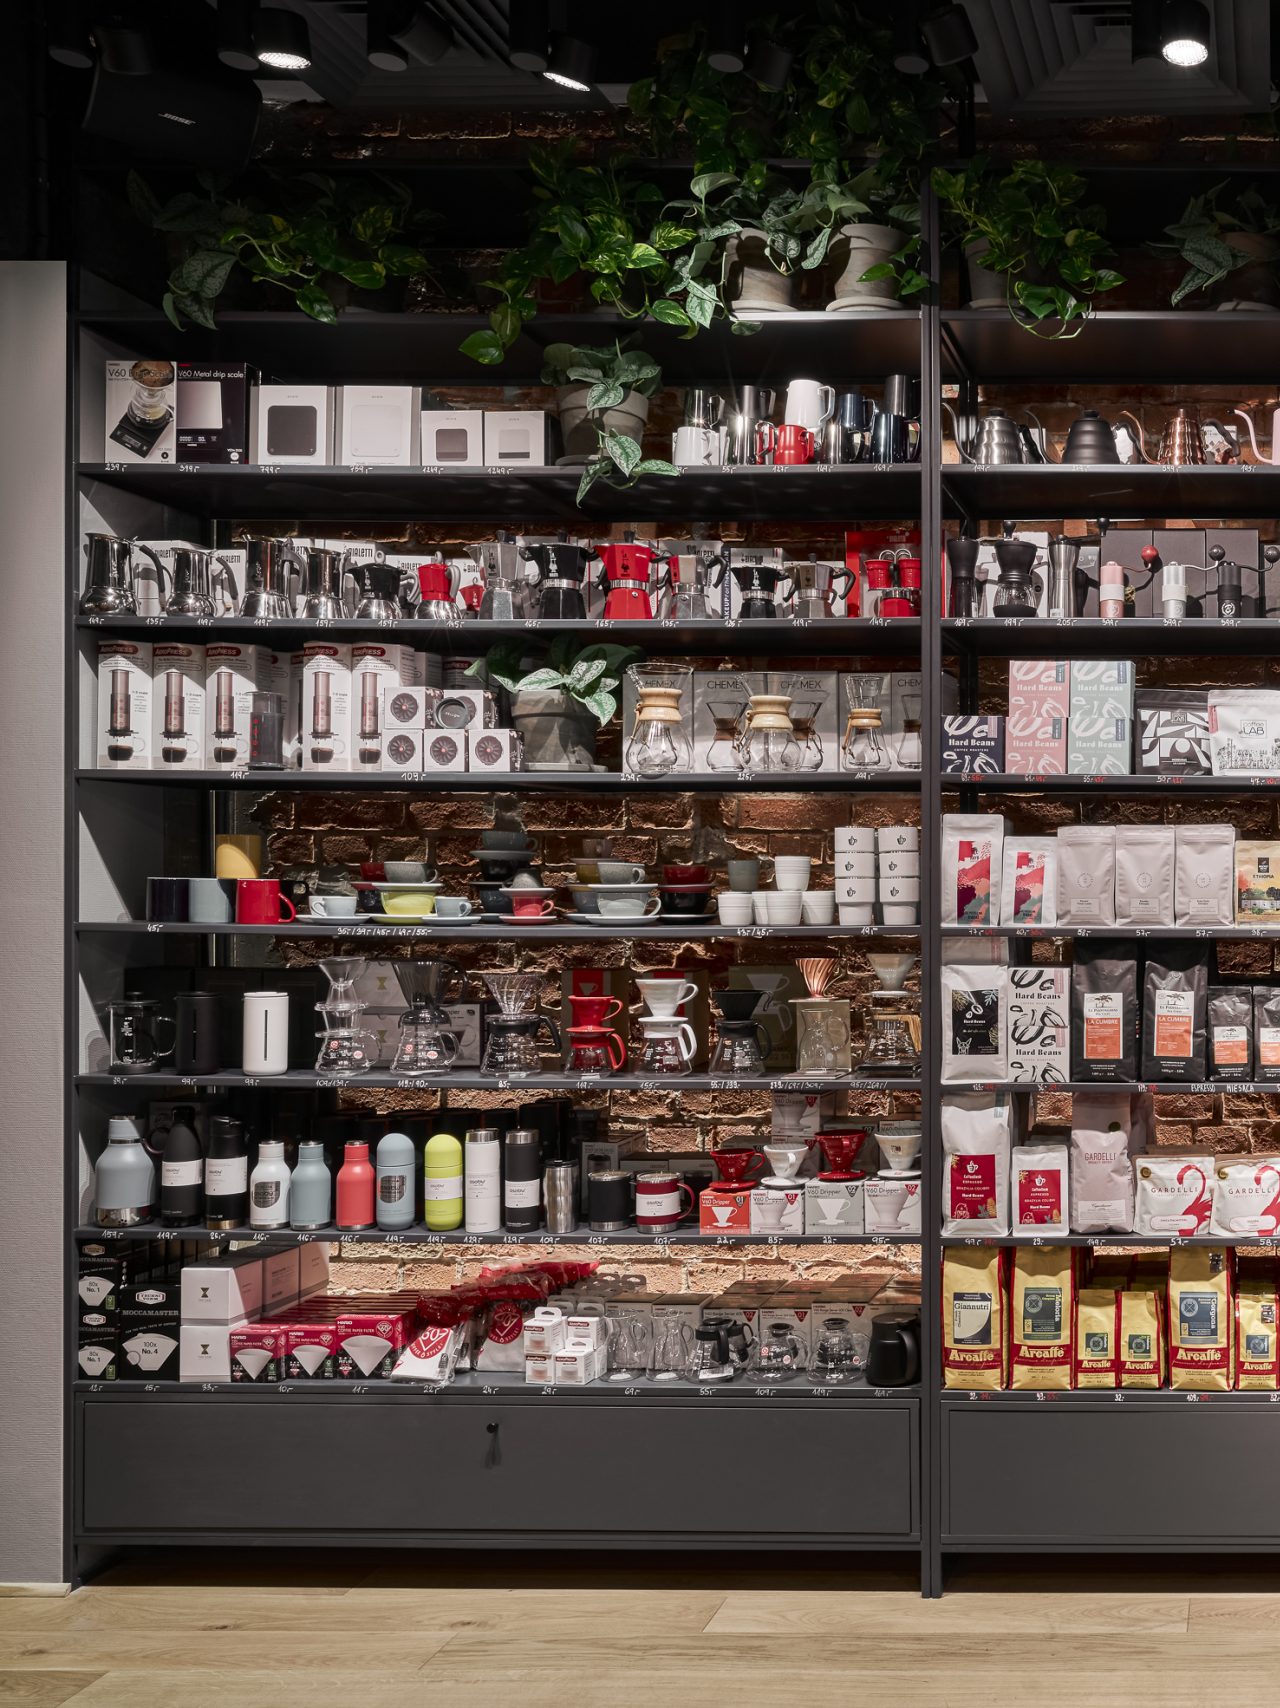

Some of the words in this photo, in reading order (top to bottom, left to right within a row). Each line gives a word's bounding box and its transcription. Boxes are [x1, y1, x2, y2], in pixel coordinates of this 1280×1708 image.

[193, 370, 211, 378] Metal
[213, 370, 225, 379] drip
[780, 679, 822, 689] CHMEX
[1017, 684, 1037, 692] Hard
[1039, 684, 1062, 692] Beans
[1078, 684, 1097, 692] Hard
[1100, 684, 1123, 692] Beans
[949, 739, 968, 747] Hard
[970, 739, 995, 747] Beans
[1013, 740, 1033, 748] Hard
[1035, 740, 1059, 748] Beans
[1016, 992, 1035, 1000] Hard
[1037, 992, 1061, 1000] Beans
[1016, 1048, 1035, 1056] Hard
[1037, 1048, 1062, 1056] Beans
[1084, 1152, 1117, 1161] GARDELLI
[1151, 1186, 1198, 1194] GARDELLI
[954, 1302, 990, 1312] Giannutri
[1019, 1345, 1065, 1358] Arcaffè
[1177, 1349, 1222, 1361] Arcaffè
[949, 1350, 994, 1362] Arcaffè
